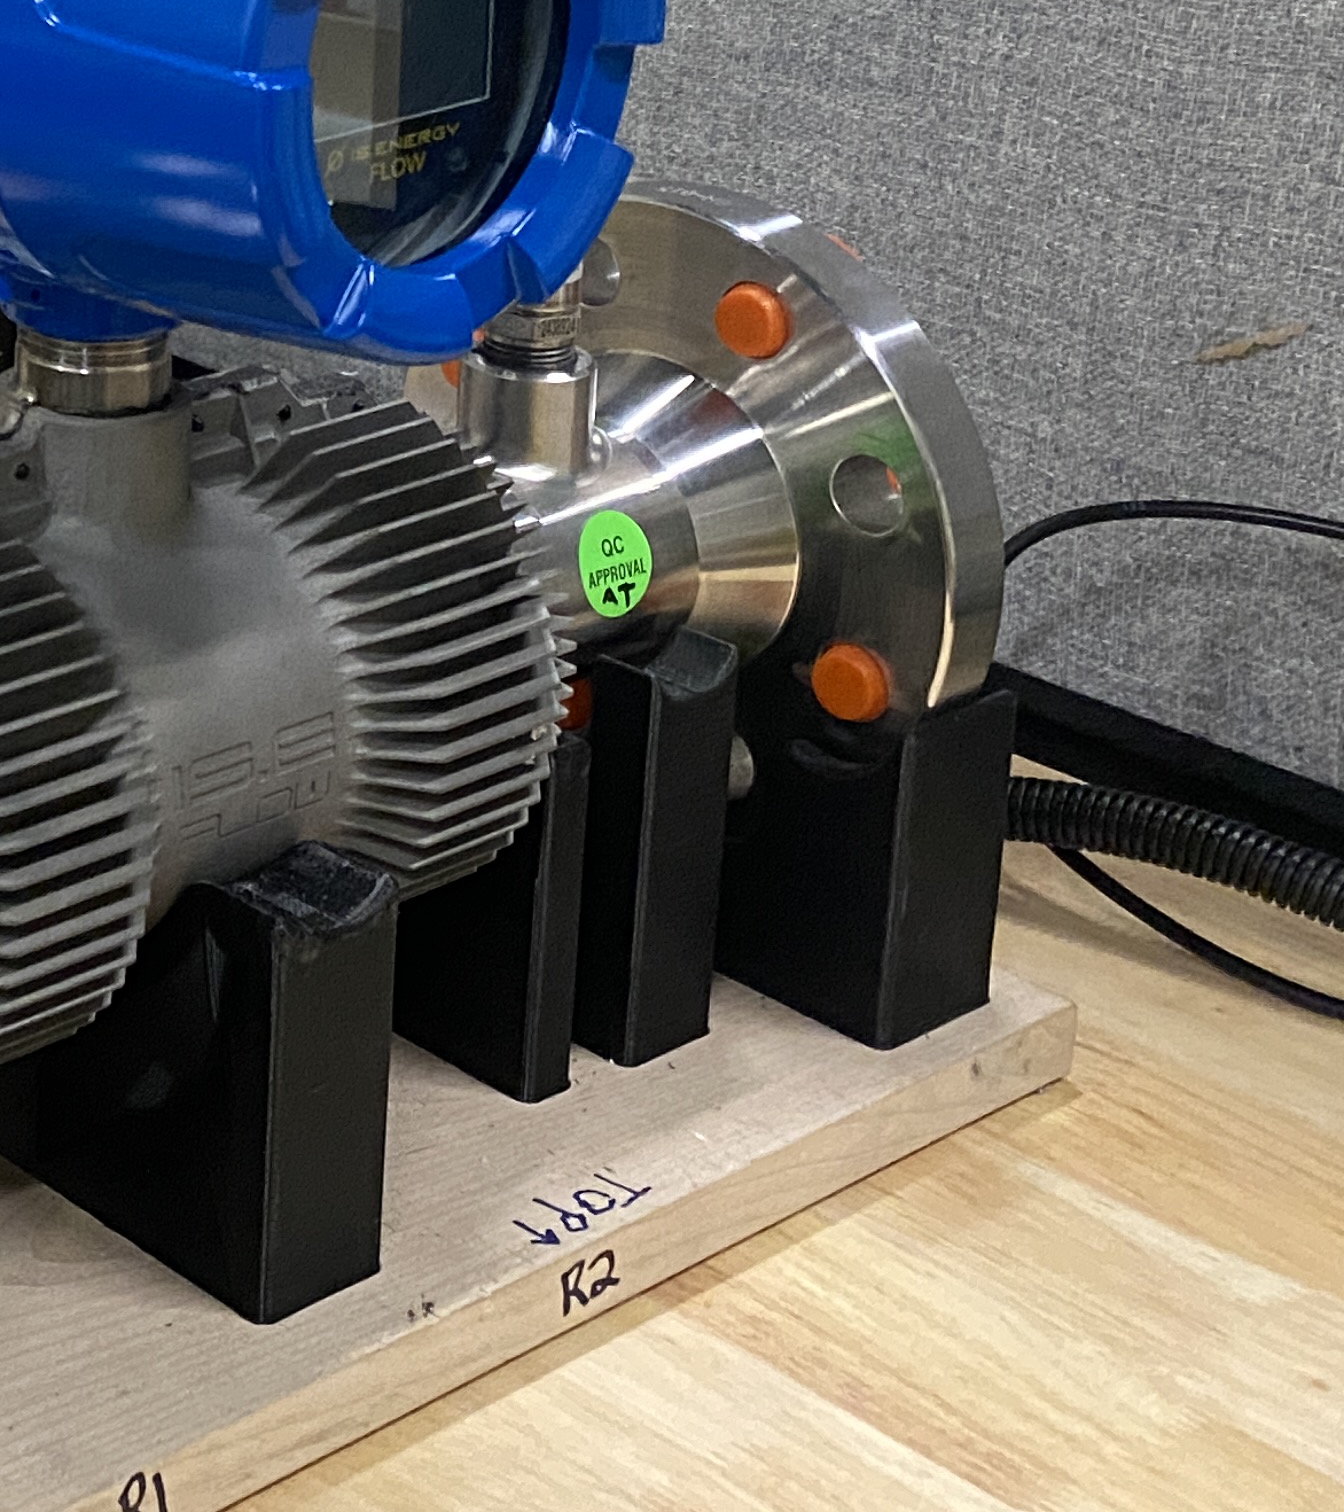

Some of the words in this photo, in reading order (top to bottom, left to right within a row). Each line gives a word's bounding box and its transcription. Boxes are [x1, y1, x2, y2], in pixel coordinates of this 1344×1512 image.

[370, 150, 427, 181] FLOW
[600, 535, 625, 558] QC
[588, 557, 648, 589] APPROVAL
[602, 582, 637, 608] AT
[531, 1172, 653, 1233] TOP
[560, 1249, 621, 1318] R2
